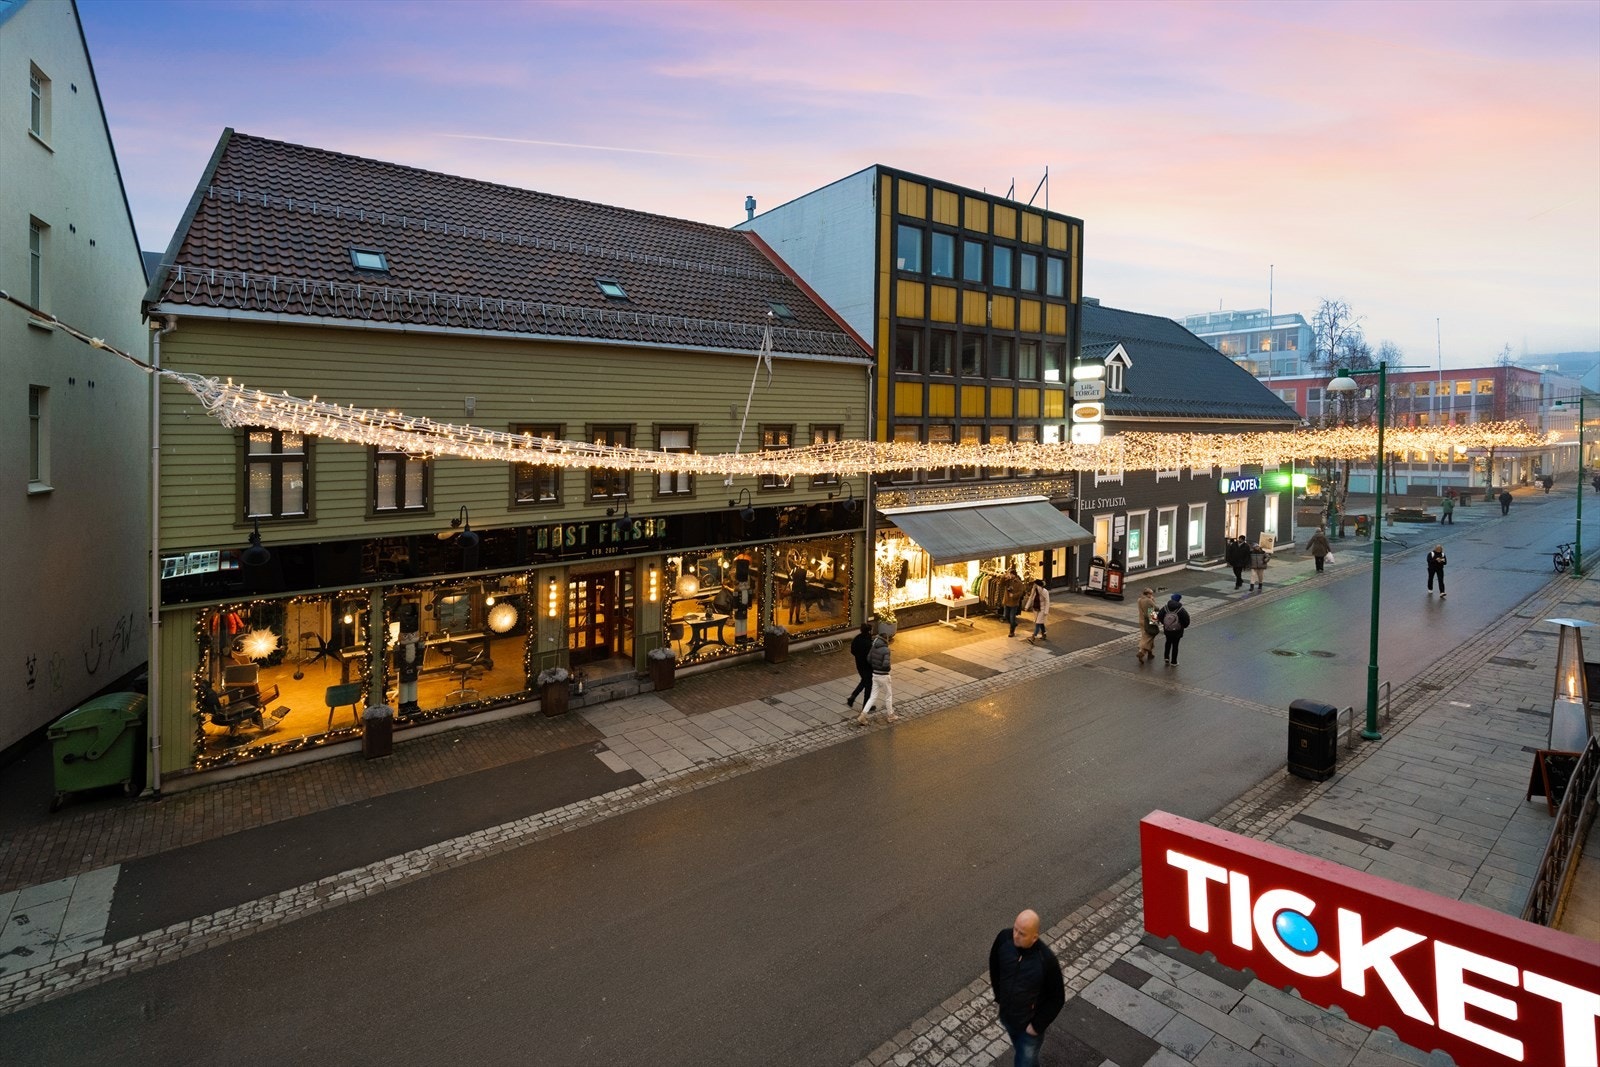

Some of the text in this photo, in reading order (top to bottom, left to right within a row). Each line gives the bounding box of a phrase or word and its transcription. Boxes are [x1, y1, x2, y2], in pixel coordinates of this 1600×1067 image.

[1230, 478, 1258, 492] APOTEK
[537, 525, 589, 549] HØST
[1166, 849, 1600, 1067] TICKET
